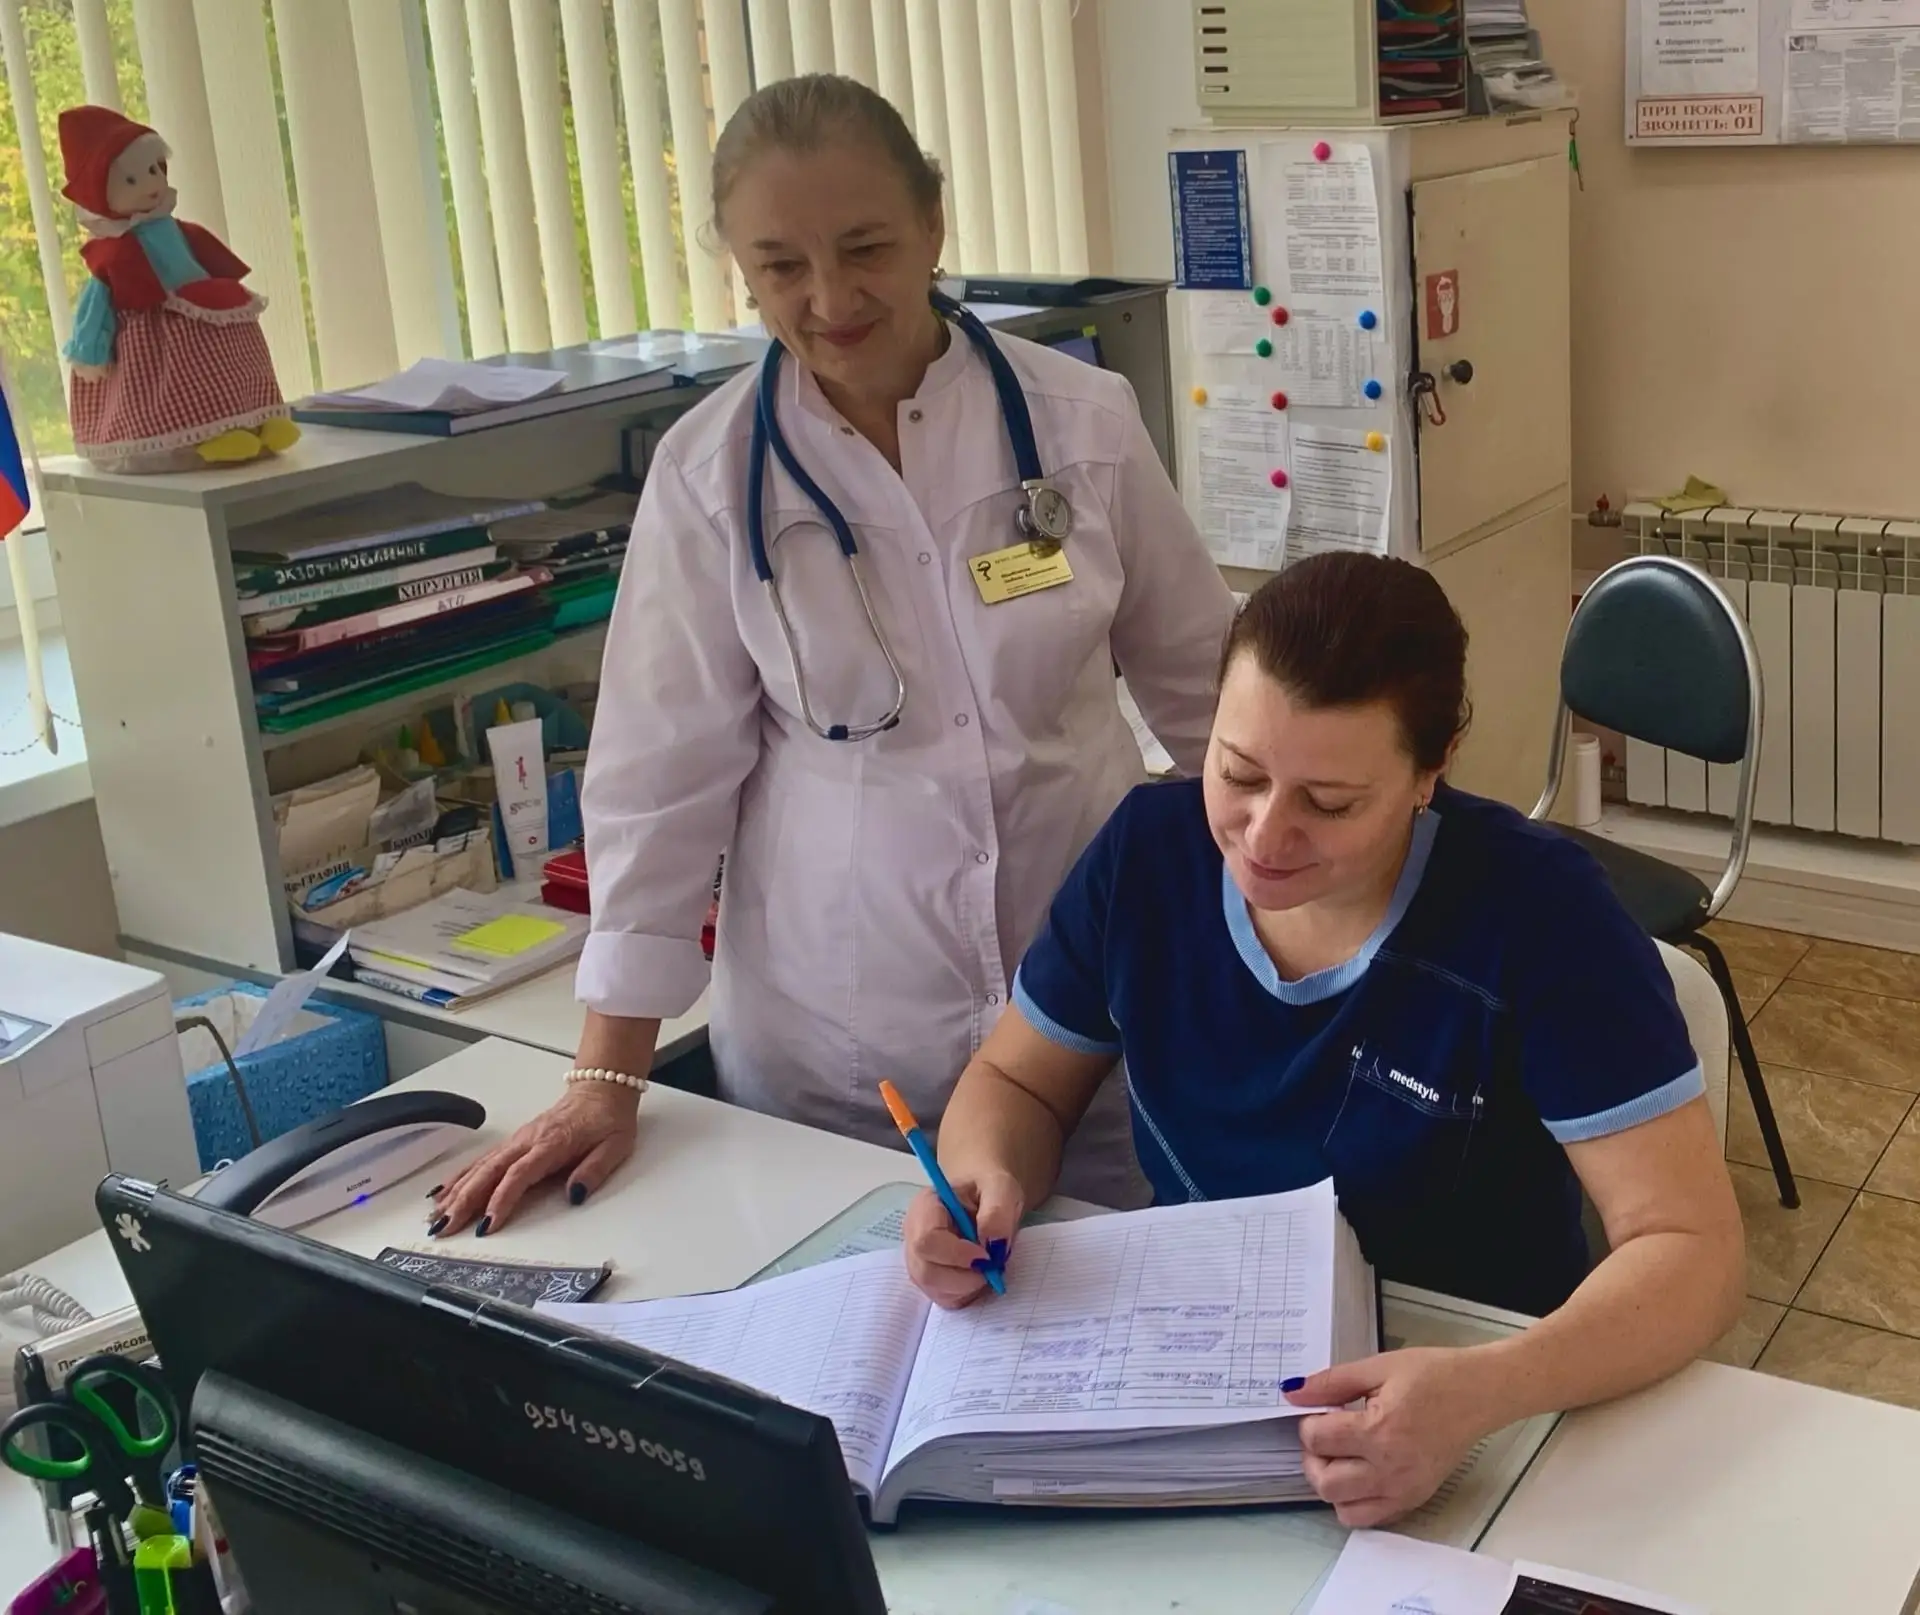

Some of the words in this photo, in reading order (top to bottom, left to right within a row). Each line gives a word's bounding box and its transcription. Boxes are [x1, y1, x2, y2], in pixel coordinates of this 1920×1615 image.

[1641, 105, 1677, 118] ПРИ
[1684, 103, 1757, 117] ПОЖАРЕ
[1734, 117, 1754, 130] 01
[401, 569, 482, 599] ХИРУРГИЯ
[1389, 1068, 1440, 1102] medstyle
